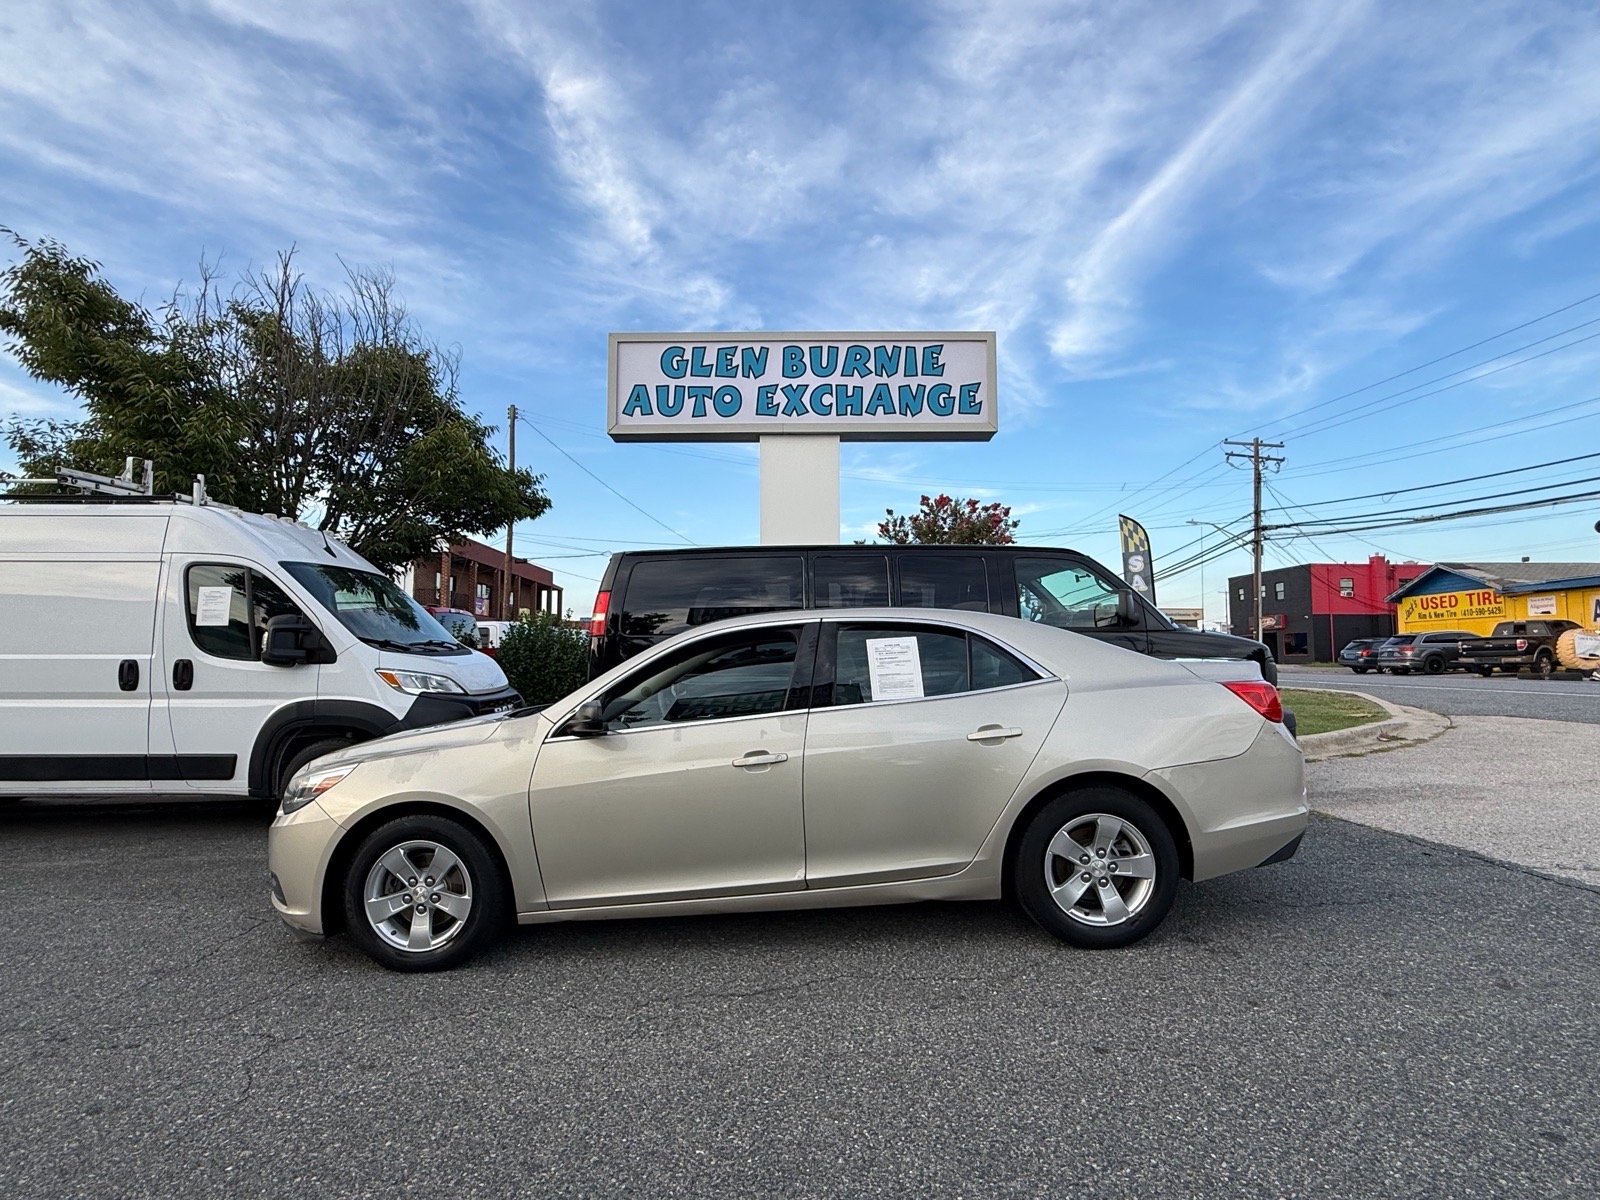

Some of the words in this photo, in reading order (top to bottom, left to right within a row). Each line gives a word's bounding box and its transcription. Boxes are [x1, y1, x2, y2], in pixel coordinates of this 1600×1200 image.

[660, 345, 769, 379] GLEN
[781, 344, 946, 379] BURNIE
[622, 383, 742, 418] AUTO
[755, 381, 983, 418] EXCHANGE
[1420, 595, 1459, 610] USED
[1446, 610, 1457, 618] Tire
